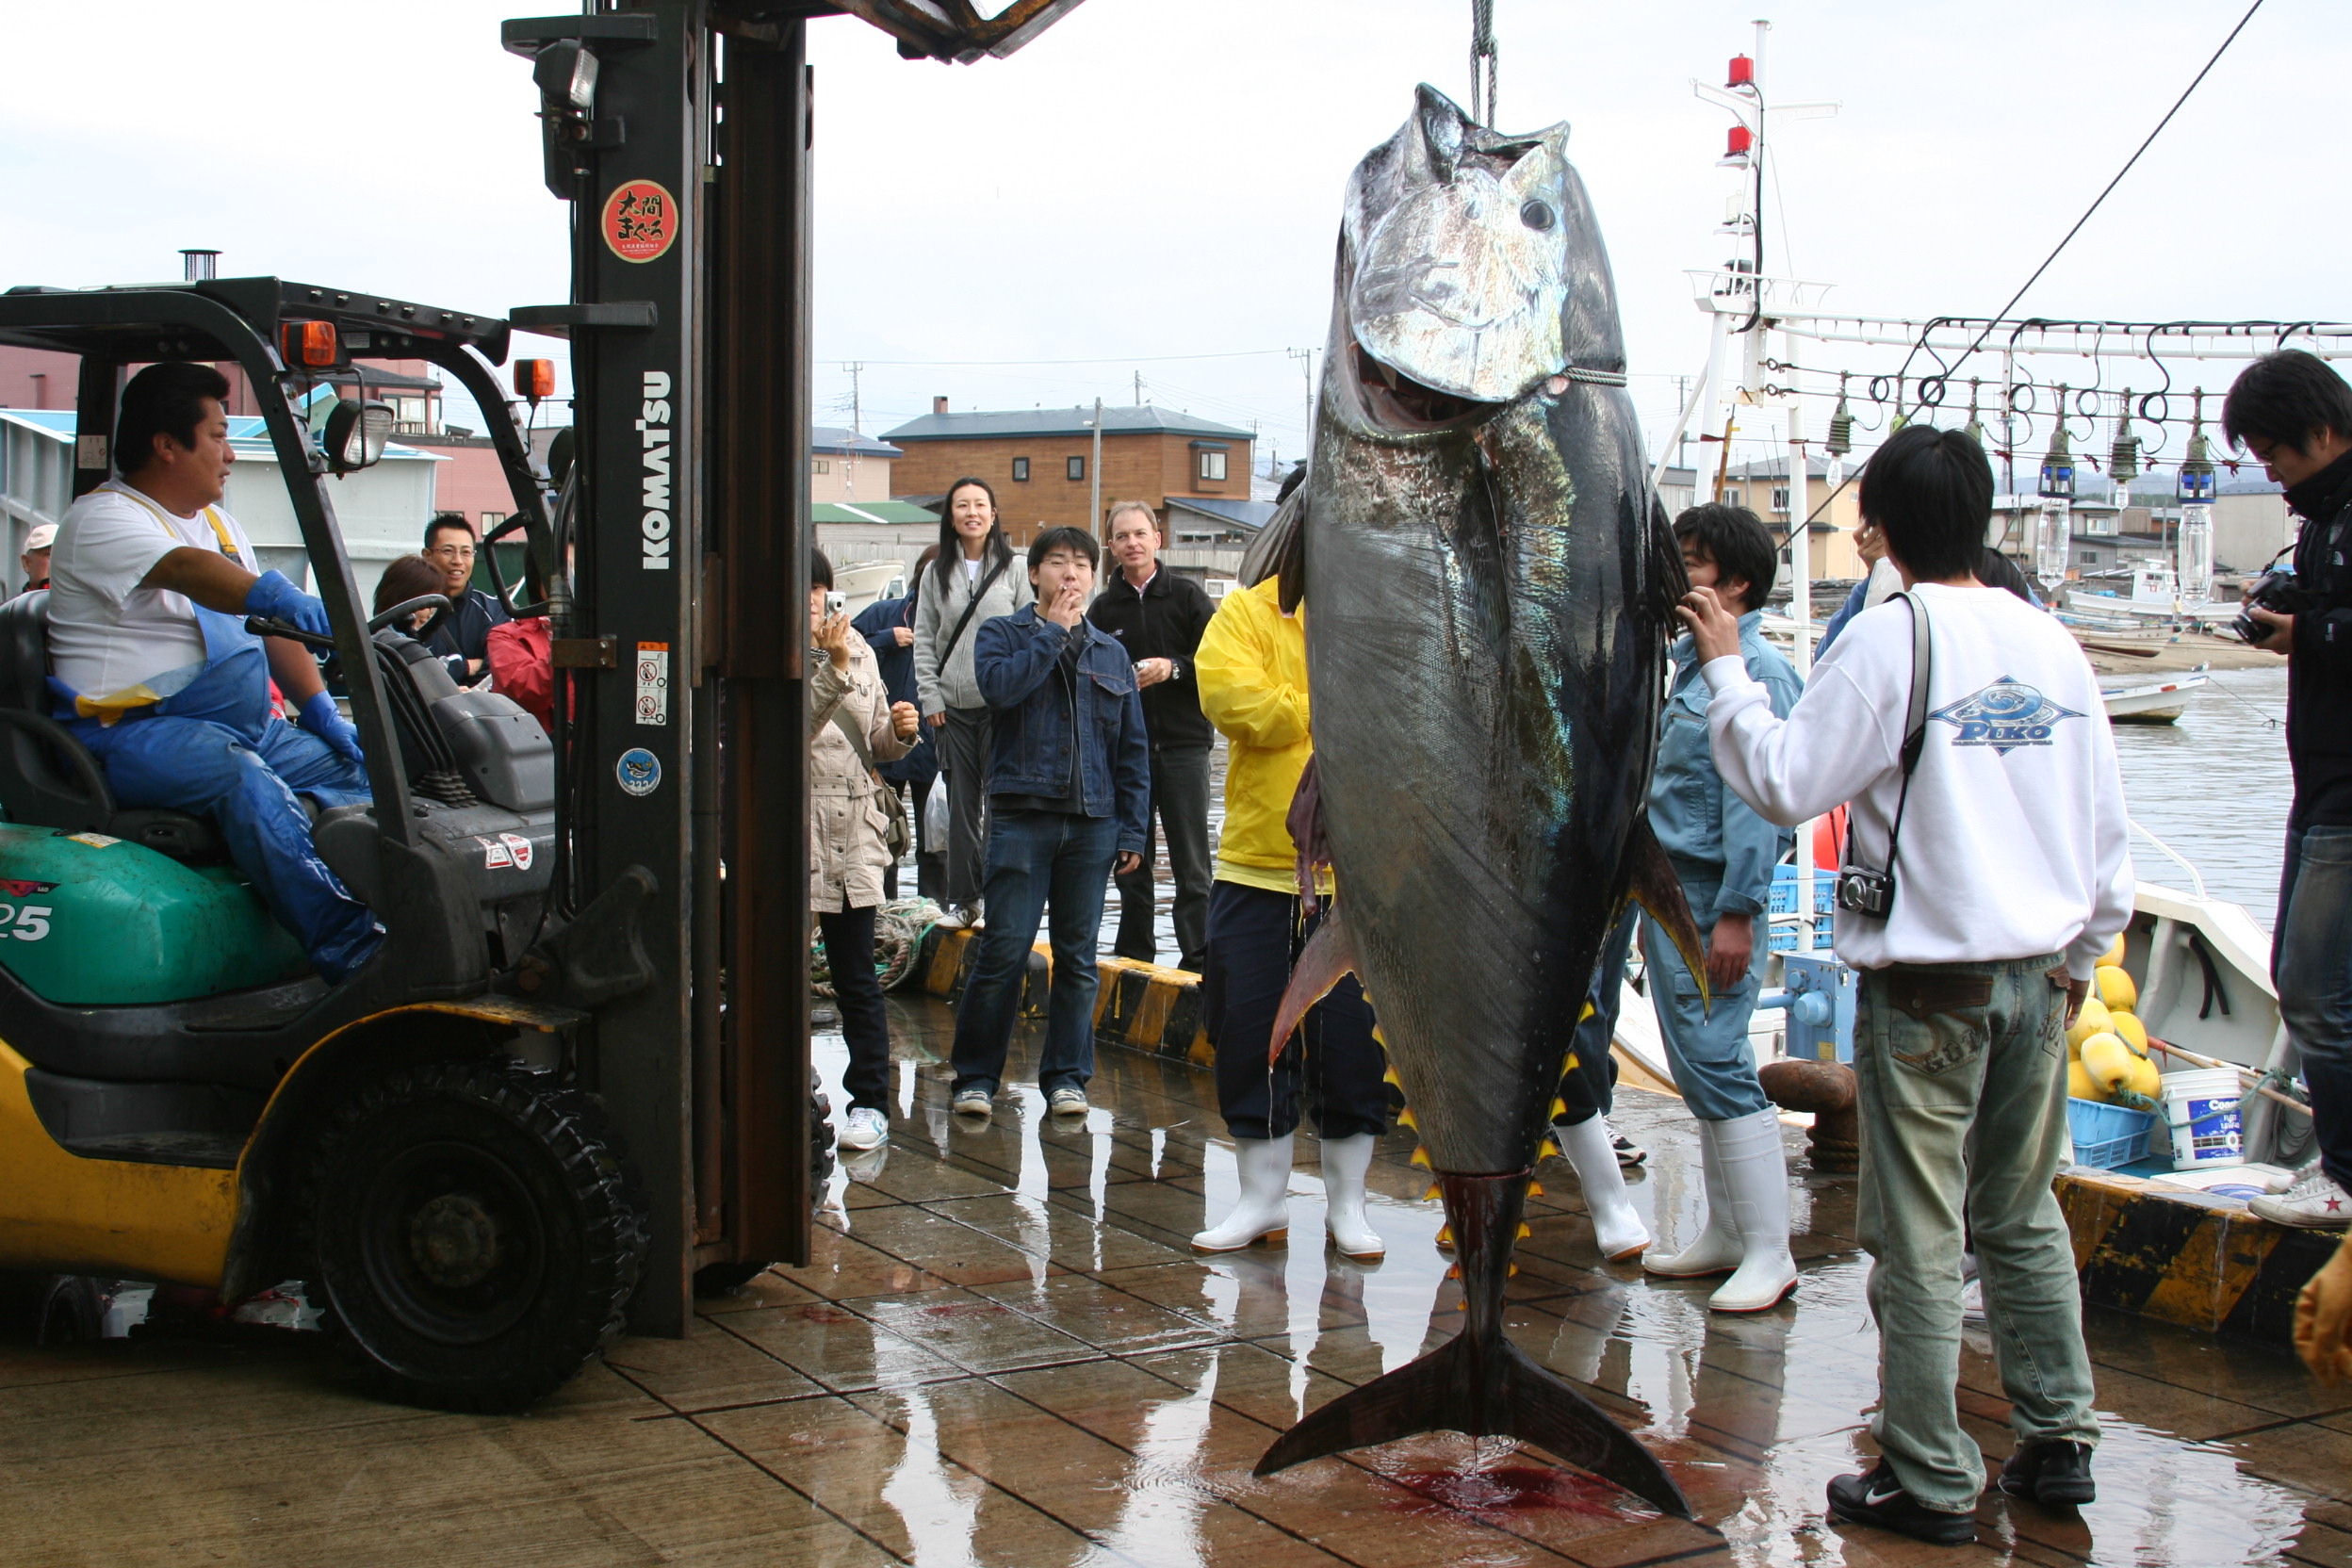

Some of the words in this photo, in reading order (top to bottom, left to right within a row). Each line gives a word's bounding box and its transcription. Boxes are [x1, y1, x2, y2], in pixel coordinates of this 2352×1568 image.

[617, 190, 663, 218] 大間
[617, 216, 663, 241] まぐろ
[635, 371, 671, 570] KOMATSU
[1952, 721, 2051, 740] PIKO
